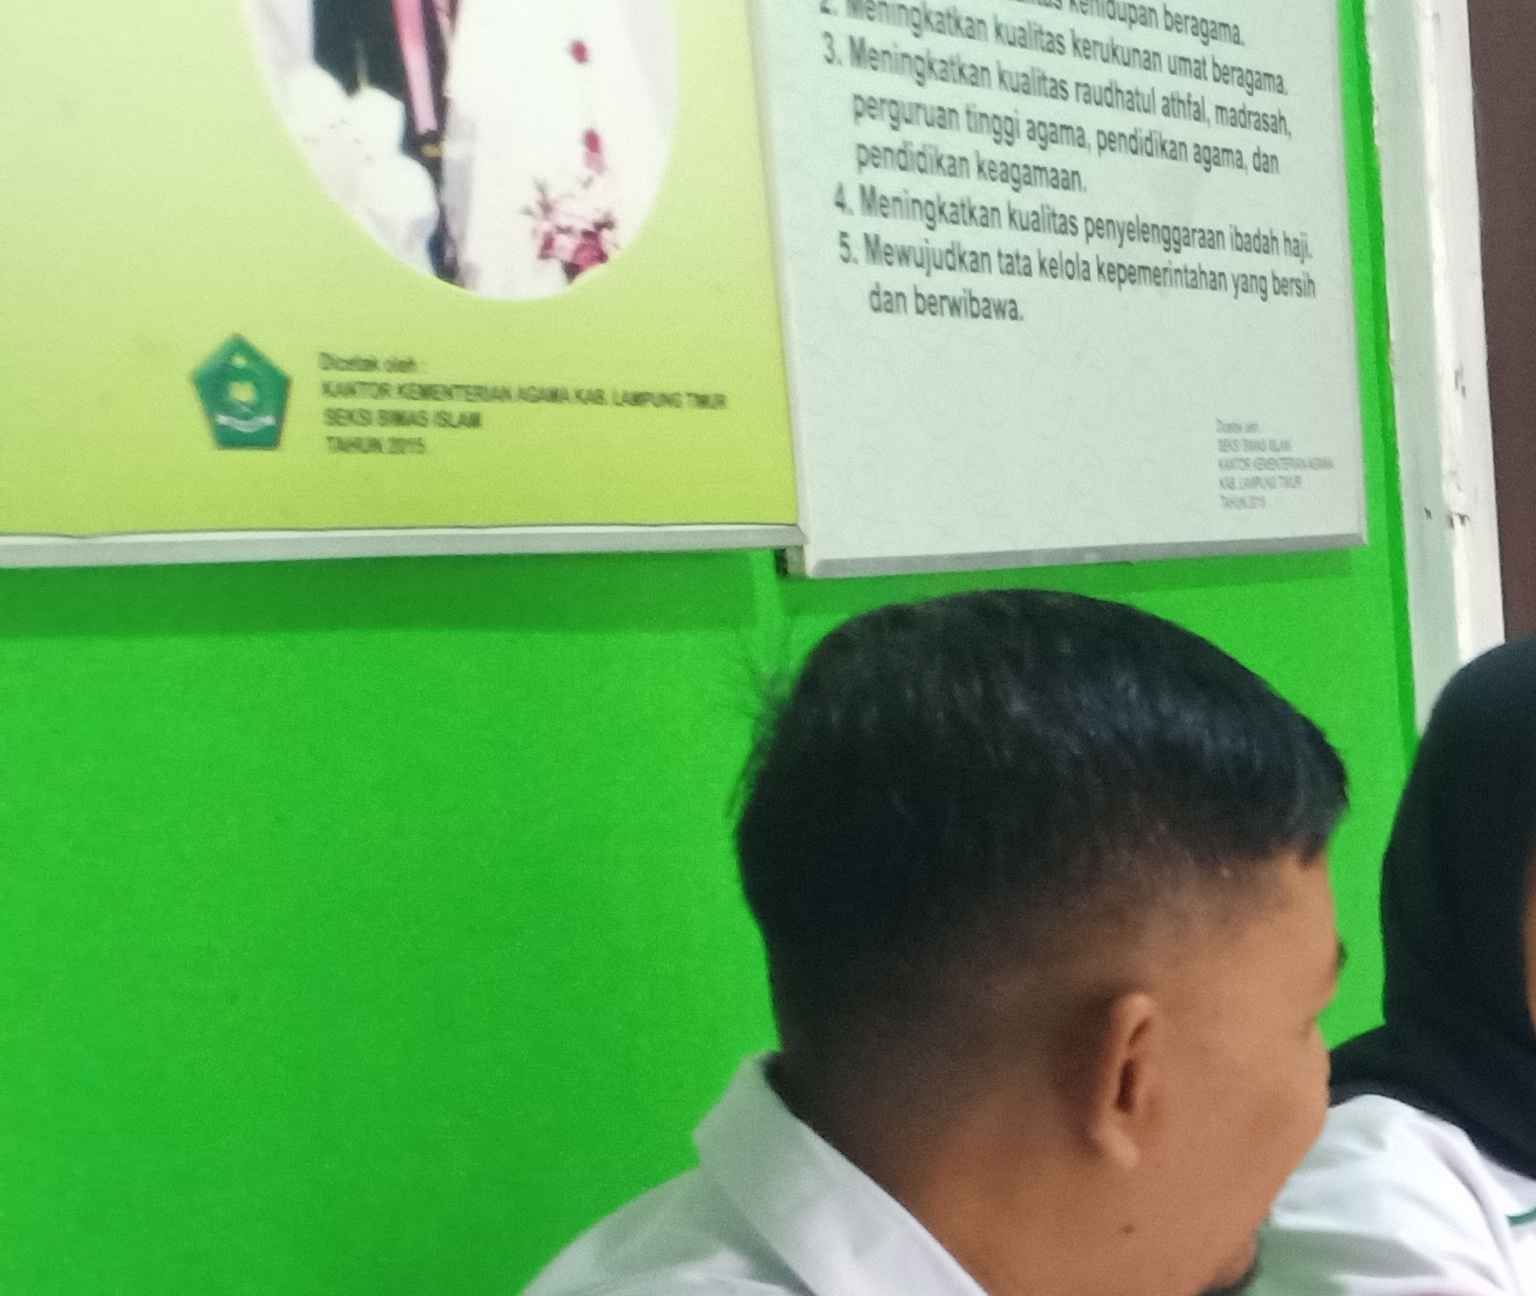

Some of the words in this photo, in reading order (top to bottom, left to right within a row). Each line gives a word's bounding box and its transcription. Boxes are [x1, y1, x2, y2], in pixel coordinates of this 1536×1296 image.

[994, 14, 1065, 55] kualitas
[1070, 28, 1162, 72] kerukunan
[1167, 53, 1208, 81] umat
[1212, 54, 1288, 96] beragama.
[1163, 3, 1245, 46] beragama.
[821, 31, 842, 66] 3.
[849, 34, 992, 88] Meningkatkan
[996, 60, 1069, 101] kualitas
[1074, 78, 1156, 115] raudhatul
[1161, 90, 1211, 128] athfal,
[1215, 102, 1292, 140] madrasah,
[852, 92, 960, 132] perguruan
[966, 103, 1020, 147] tinggi
[1026, 117, 1091, 152] agama,
[1097, 127, 1188, 163] pendidikan
[1193, 142, 1249, 175] agama,
[1253, 145, 1280, 174] dan
[856, 140, 970, 179] pendidikan
[976, 150, 1087, 193] keagamaan.
[834, 181, 855, 216] 4.
[859, 183, 1002, 231] Meningkatkan
[1007, 200, 1079, 235] kualitas
[1084, 214, 1226, 254] penyelenggaraan
[1230, 223, 1279, 256] ibadah
[1283, 230, 1313, 264] haji.
[838, 230, 858, 265] 5.
[863, 232, 993, 278] Mewujudkan
[997, 249, 1033, 278] tata
[1038, 248, 1091, 282] kelola
[1096, 254, 1228, 293] kepemerintahan
[1231, 271, 1268, 302] yang
[1271, 269, 1316, 298] bersih
[868, 281, 908, 315] dan
[913, 283, 1024, 322] berwibawa.
